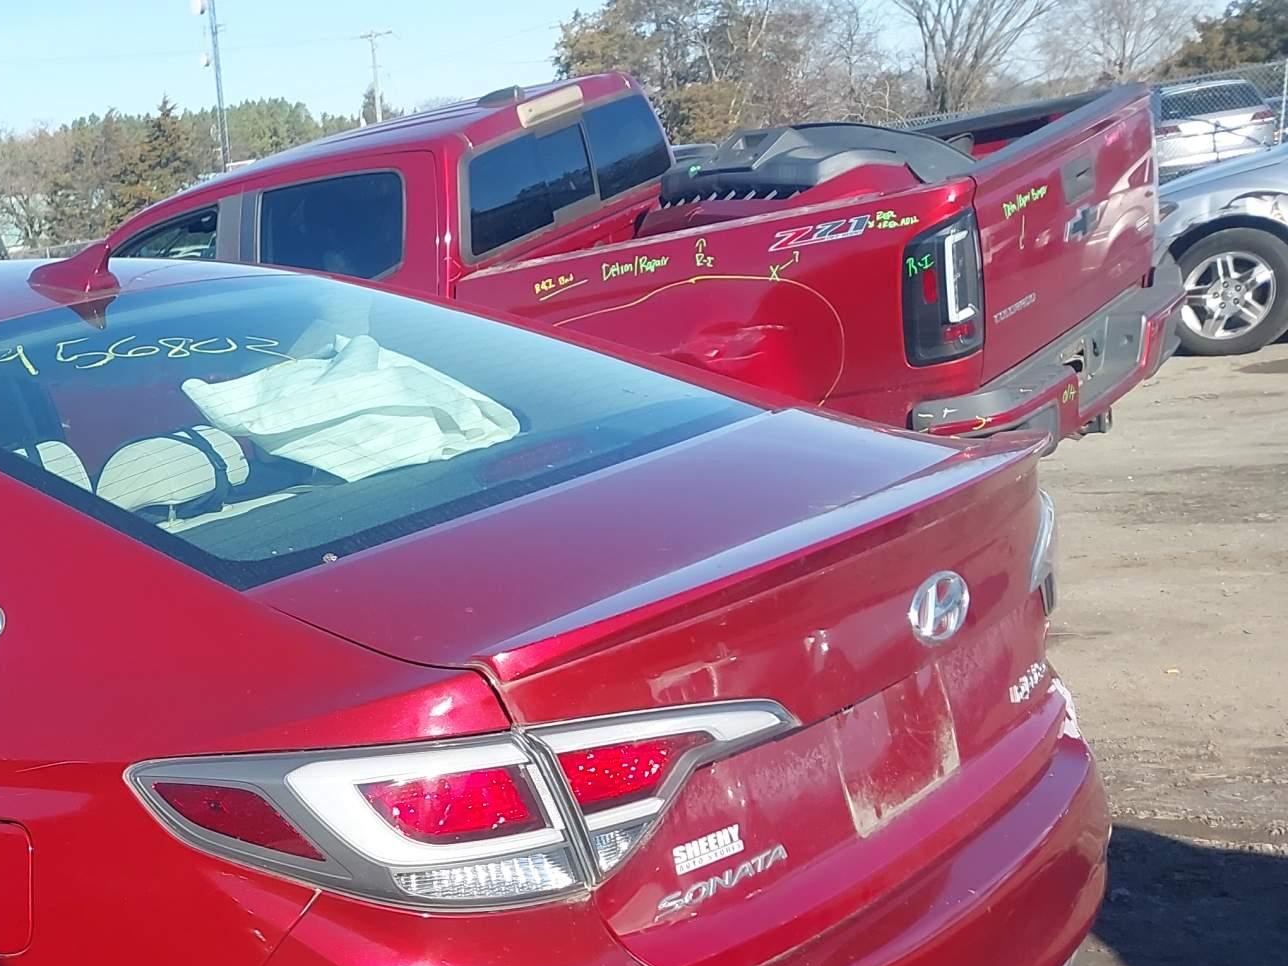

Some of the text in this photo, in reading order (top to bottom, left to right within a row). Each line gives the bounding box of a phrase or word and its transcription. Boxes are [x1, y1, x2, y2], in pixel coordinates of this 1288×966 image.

[768, 214, 871, 252] Z71
[673, 824, 739, 864] SHEEHY
[654, 844, 789, 922] SONATA
